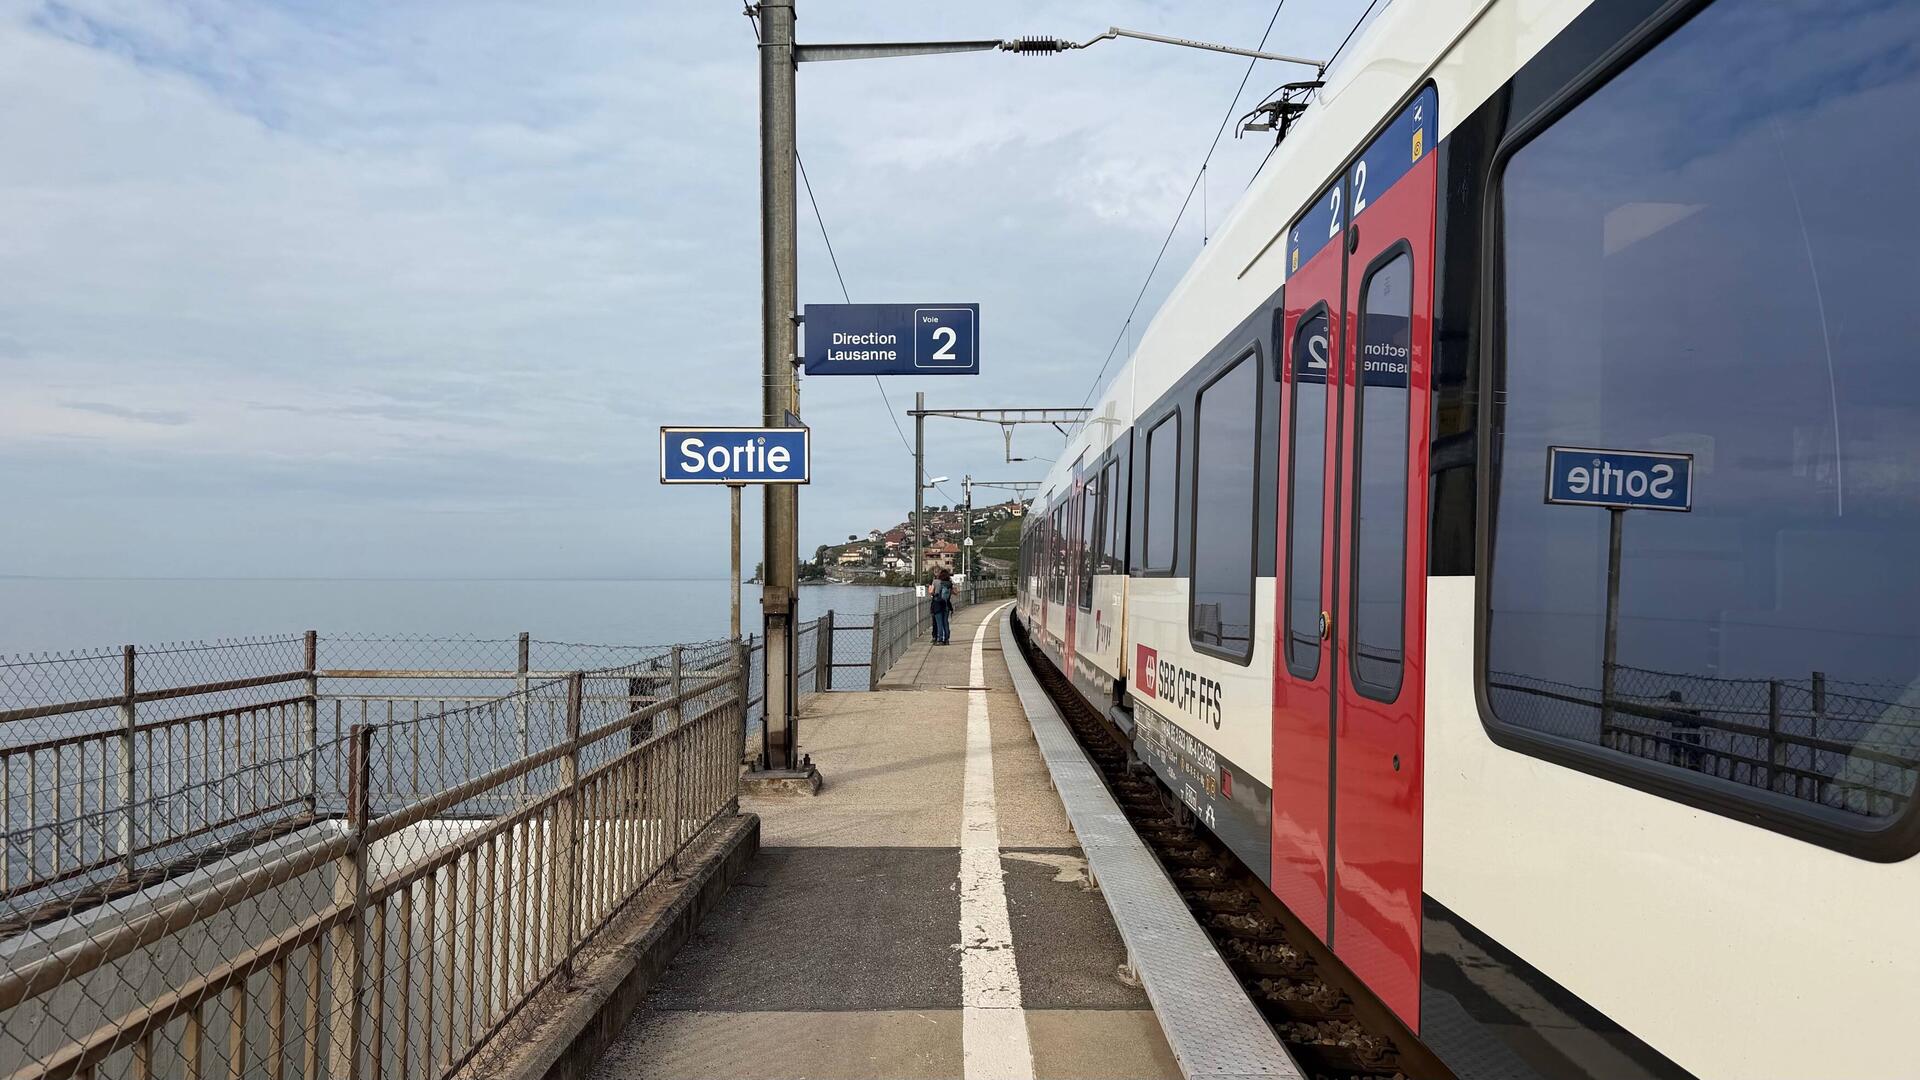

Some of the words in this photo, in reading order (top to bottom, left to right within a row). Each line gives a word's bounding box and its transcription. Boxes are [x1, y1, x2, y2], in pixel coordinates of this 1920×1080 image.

[1354, 161, 1366, 216] 2
[1329, 186, 1340, 238] 2
[922, 315, 939, 323] Voie
[827, 348, 897, 362] Lausanne
[832, 332, 896, 345] Direction
[932, 327, 957, 360] 2
[680, 437, 790, 473] Sortie
[1158, 659, 1175, 704] SBB
[1177, 667, 1197, 715] CFF
[1198, 675, 1222, 731] FFS
